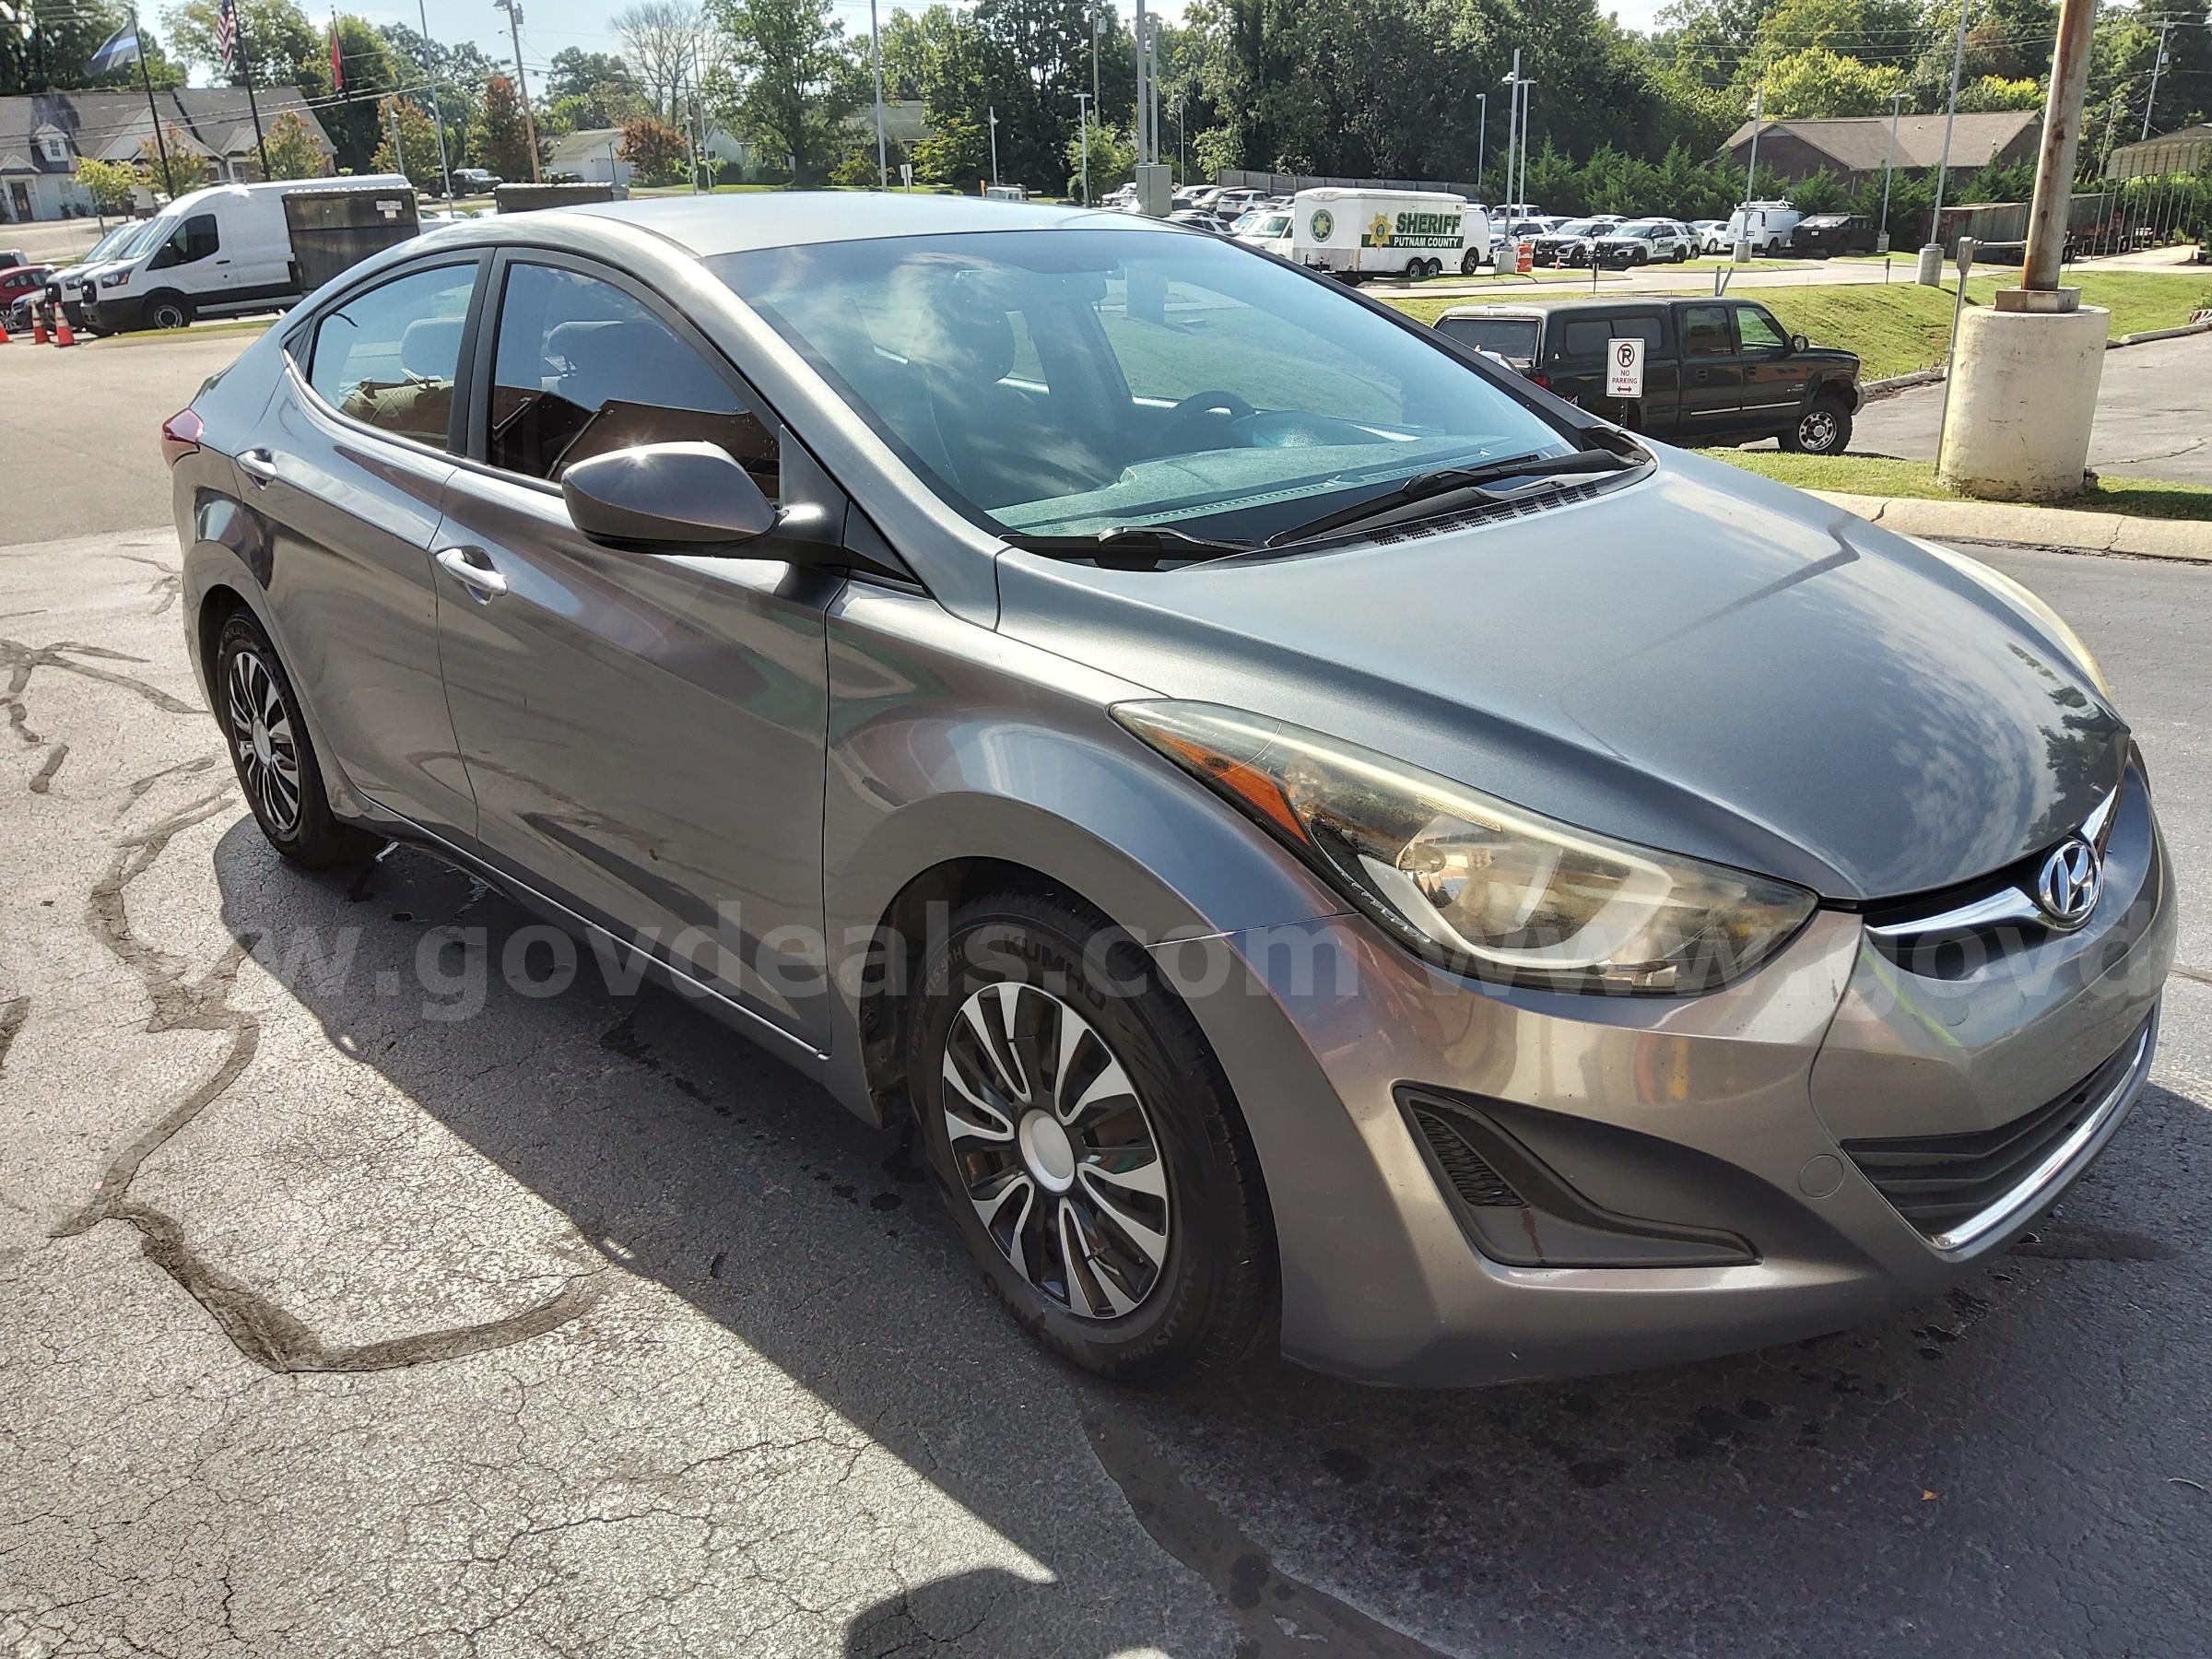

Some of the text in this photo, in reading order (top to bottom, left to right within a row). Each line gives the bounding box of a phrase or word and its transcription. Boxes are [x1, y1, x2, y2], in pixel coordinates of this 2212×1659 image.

[1396, 212, 1462, 234] SHERIFF
[1394, 237, 1459, 248] PUTNAM COUNTY
[1003, 932, 1107, 1011] KUMHO
